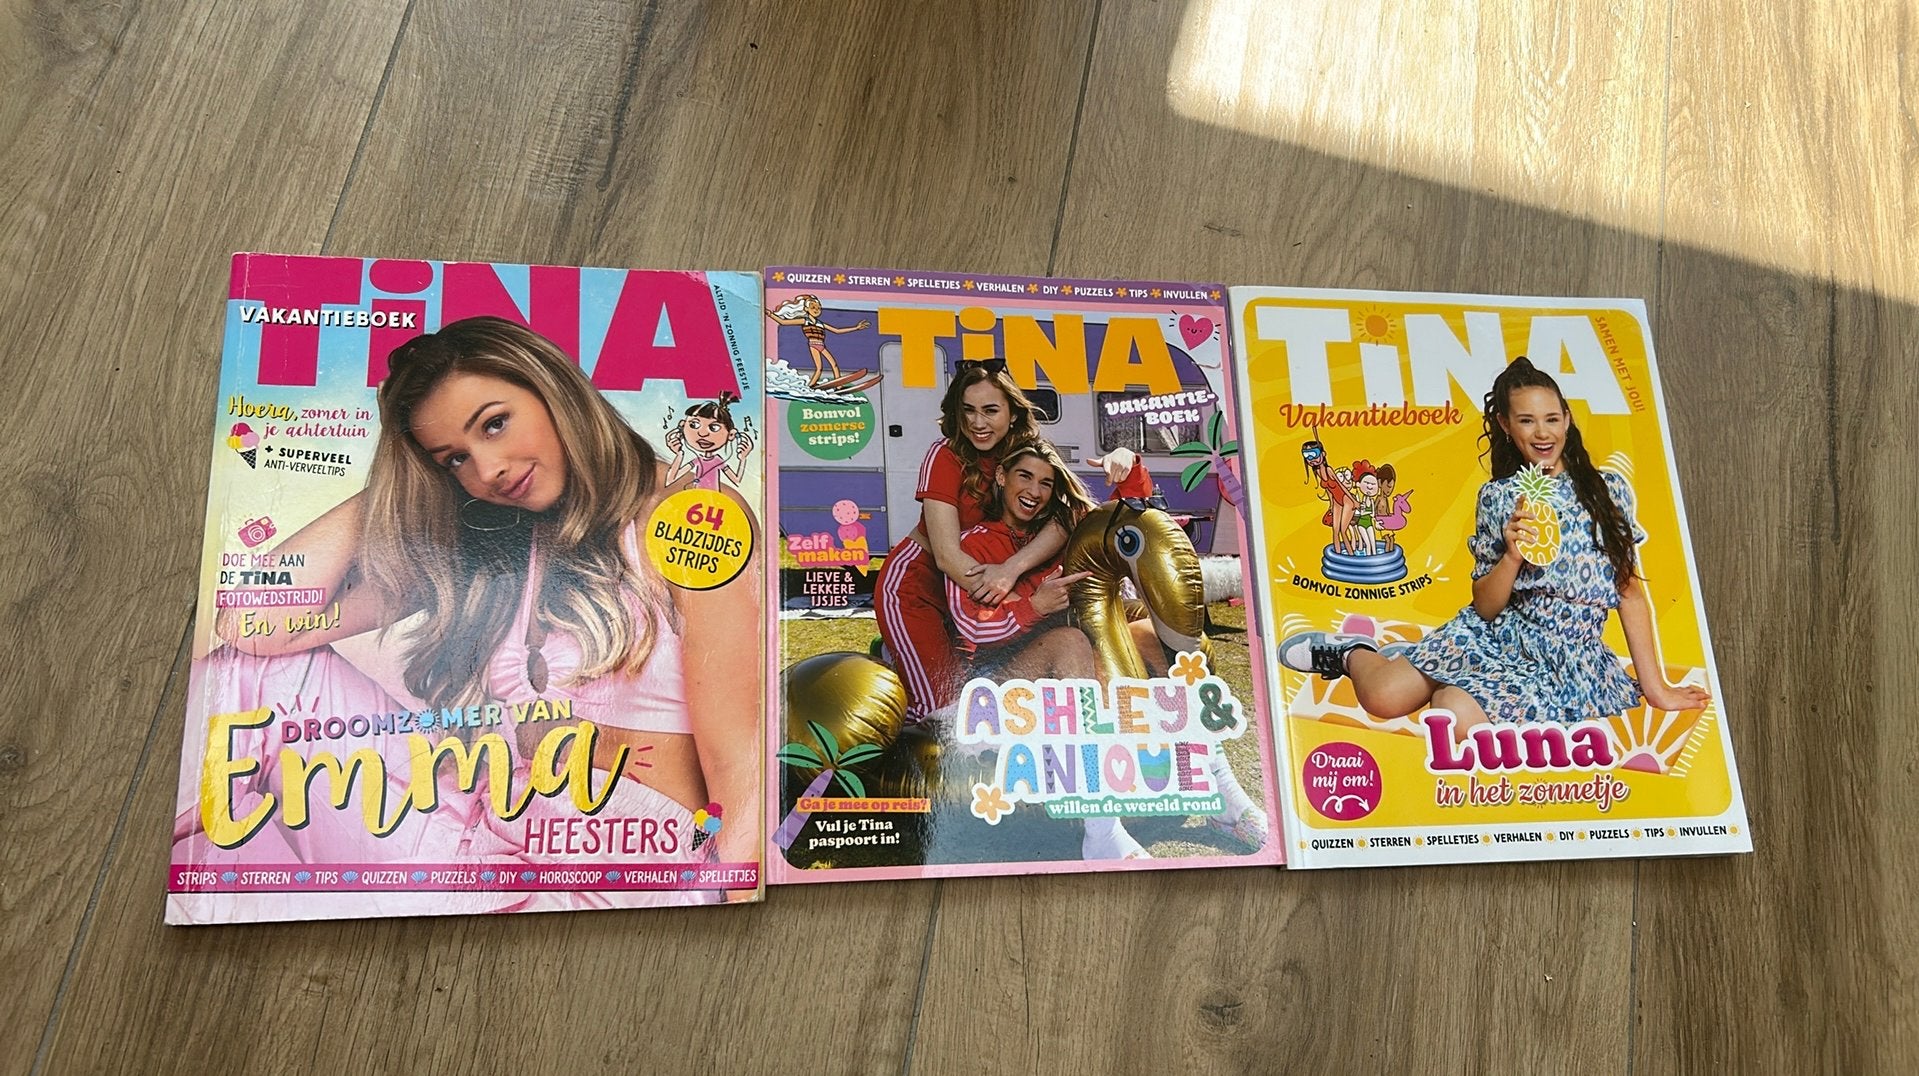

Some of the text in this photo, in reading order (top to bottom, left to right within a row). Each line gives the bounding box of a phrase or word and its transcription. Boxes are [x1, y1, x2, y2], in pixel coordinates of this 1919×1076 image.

[787, 273, 1208, 300] QUIZZEN STERREN SPELLETJES VERHALEN DIY PUZZELS TIPS INVULLEN
[239, 306, 417, 329] VAKANTIEBOEK
[714, 285, 727, 311] ALTIJD
[725, 323, 741, 356] ZONNIG
[735, 358, 750, 391] FEESTJE
[1595, 316, 1646, 412] SAMEN MET JOU!
[227, 396, 374, 421] Hoera, zomer in
[1105, 390, 1215, 416] VAKANTIE-
[802, 407, 861, 420] Bomvol
[1144, 409, 1200, 425] BOEK
[1279, 400, 1463, 429] Vakantieboek
[263, 423, 370, 439] je achtertuin
[800, 421, 865, 433] zomerse
[808, 432, 860, 446] strips!
[279, 447, 352, 465] SUPERVEEL
[264, 459, 346, 477] ANTI-VERVEELTIPS
[686, 503, 724, 531] 64
[654, 521, 742, 557] BLADZIJDES
[789, 534, 829, 551] Zelf
[222, 553, 305, 567] DOE MEE AAN
[666, 547, 719, 573] STRIPS
[798, 548, 864, 562] maken
[220, 571, 238, 584] DE
[806, 572, 853, 582] LIEVE &
[1292, 573, 1433, 600] BOMVOL ZONNIGE STRIPS
[219, 588, 323, 606] FOTOWEDSTRIJD!
[803, 584, 856, 594] LEKKERE
[811, 596, 848, 606] IJSJES
[240, 602, 341, 638] En win!
[512, 698, 572, 724] VAN
[964, 683, 1240, 735] ASHLEY &
[1424, 715, 1613, 771] Luna
[1003, 742, 1212, 794] ANIQUE
[1311, 751, 1364, 768] Draai
[201, 706, 630, 850] Emma
[1312, 769, 1374, 794] mij om!
[1436, 774, 1629, 811] in het zonnetje
[800, 799, 928, 812] Ga je mee op reis?
[1049, 797, 1222, 814] willen de wereld rond
[524, 818, 680, 855] HEESTERS
[816, 819, 893, 834] Vul je Tina
[809, 832, 900, 849] paspoort in!
[1311, 825, 1727, 850] QUIZZEN STERREN SPELLETJES VERHALEN DIY PUZZELS TIPS INVULLEN
[177, 869, 757, 885] STRIPS STERREN TIPS QUIZZEN PUZZELS DIY HOROSCOOP VERHALEN SPELLETJES
